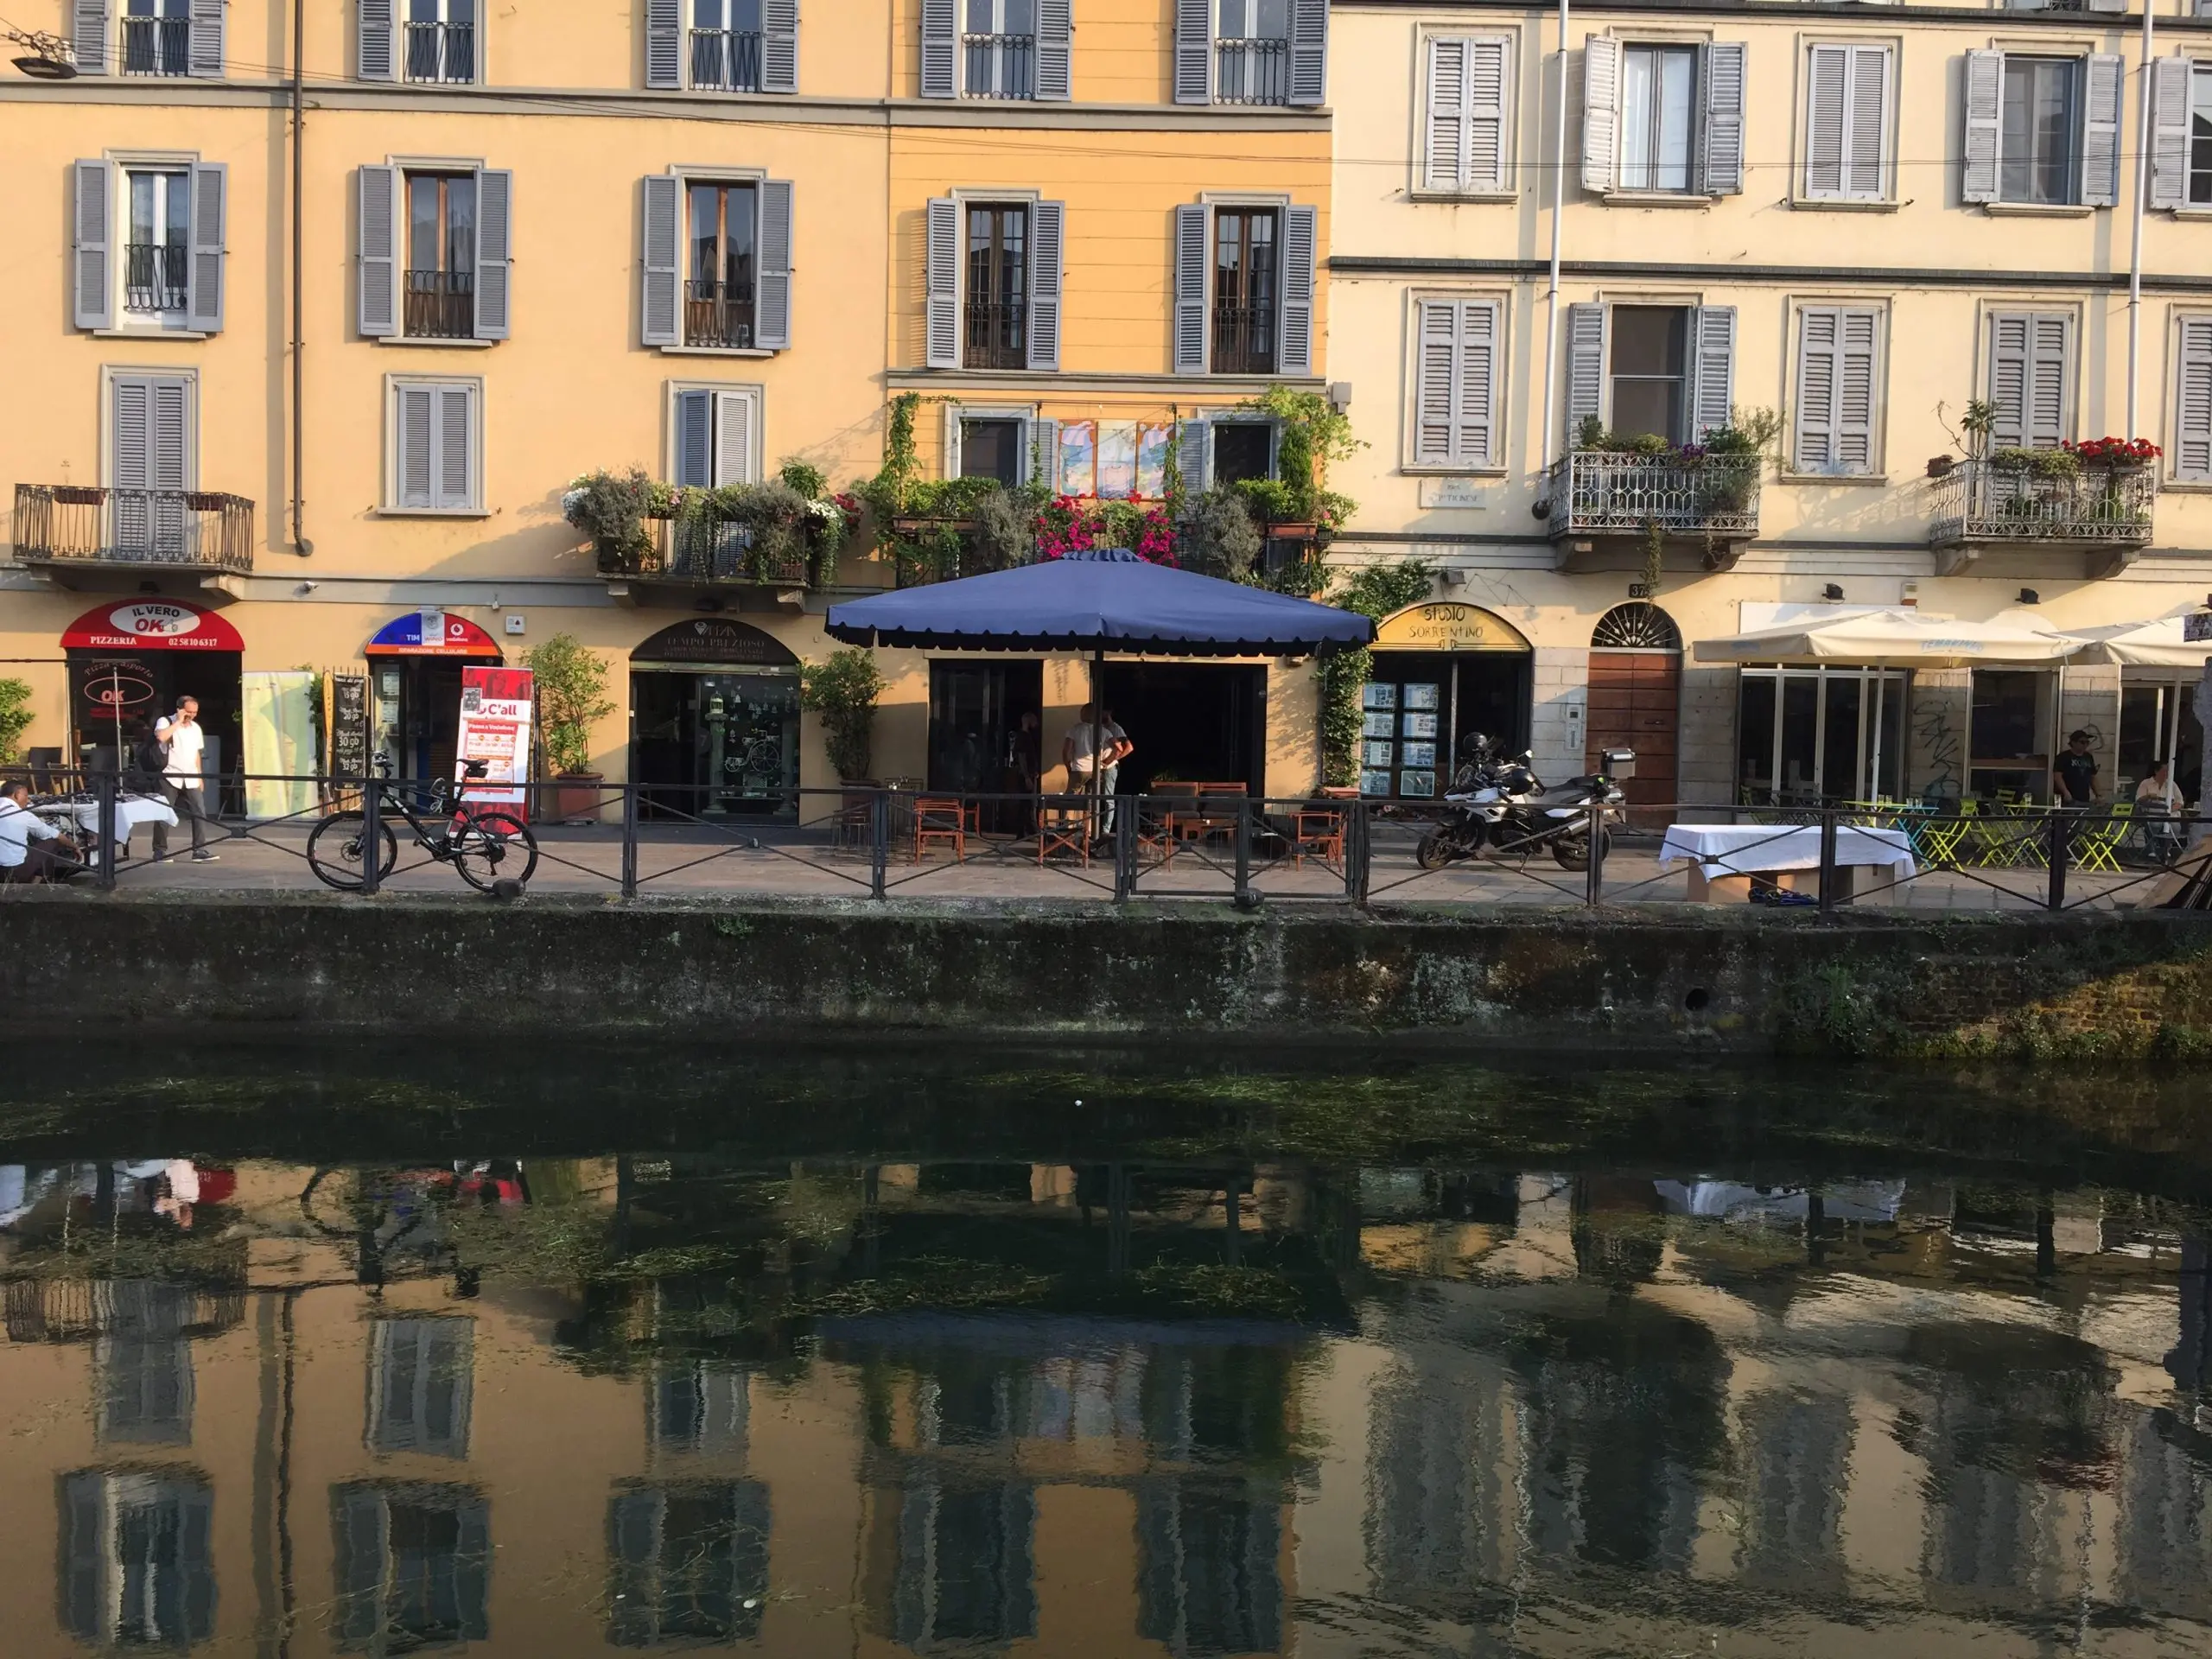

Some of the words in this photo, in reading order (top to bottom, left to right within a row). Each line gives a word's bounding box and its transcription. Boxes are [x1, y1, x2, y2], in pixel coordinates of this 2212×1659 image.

[132, 607, 145, 618] IL
[146, 606, 181, 619] VERO
[1424, 606, 1465, 622] STUDIO
[135, 618, 164, 632] OK
[90, 636, 137, 645] PIZZERIA
[667, 636, 705, 646] TEMPO
[101, 690, 125, 702] OK
[488, 703, 517, 715] C'all
[338, 736, 349, 747] 30
[349, 735, 359, 748] gb
